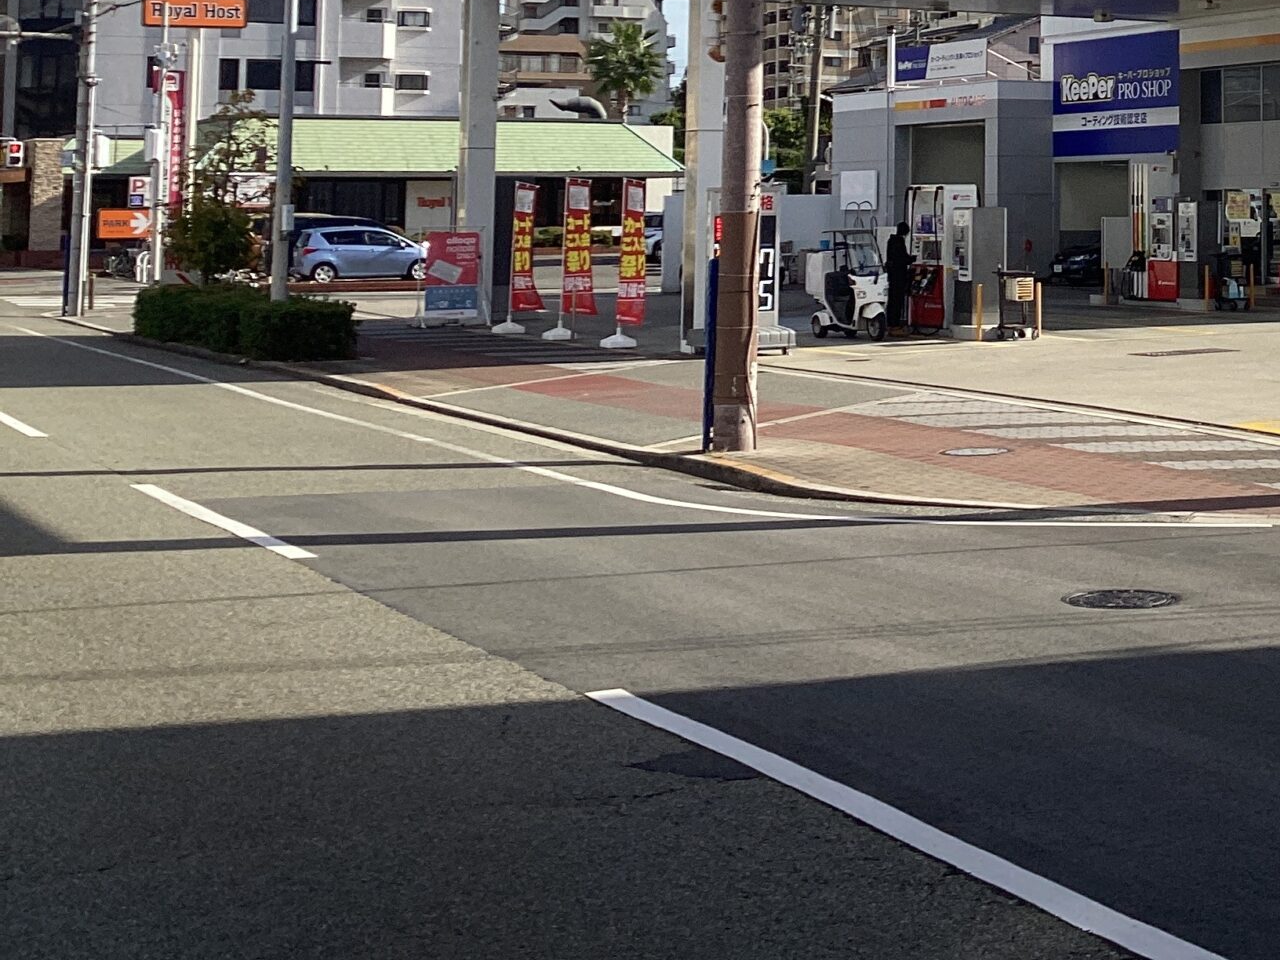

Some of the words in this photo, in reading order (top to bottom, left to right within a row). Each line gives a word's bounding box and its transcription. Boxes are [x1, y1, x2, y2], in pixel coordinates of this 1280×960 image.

[151, 1, 197, 21] Royal
[203, 3, 241, 19] Host
[1118, 67, 1171, 79] キーパープロショップ
[1061, 72, 1116, 104] KeePer
[1117, 81, 1140, 100] PRO
[1141, 79, 1172, 98] SHOP
[132, 179, 145, 192] P
[761, 194, 774, 211] 格
[566, 213, 591, 231] カード
[623, 215, 645, 234] カード
[514, 234, 531, 248] 入会
[565, 233, 591, 248] ご入会
[621, 235, 646, 252] ご入会
[566, 250, 591, 272] 祭り
[620, 254, 646, 278] 祭り
[759, 248, 775, 278] 7
[758, 279, 774, 311] 5
